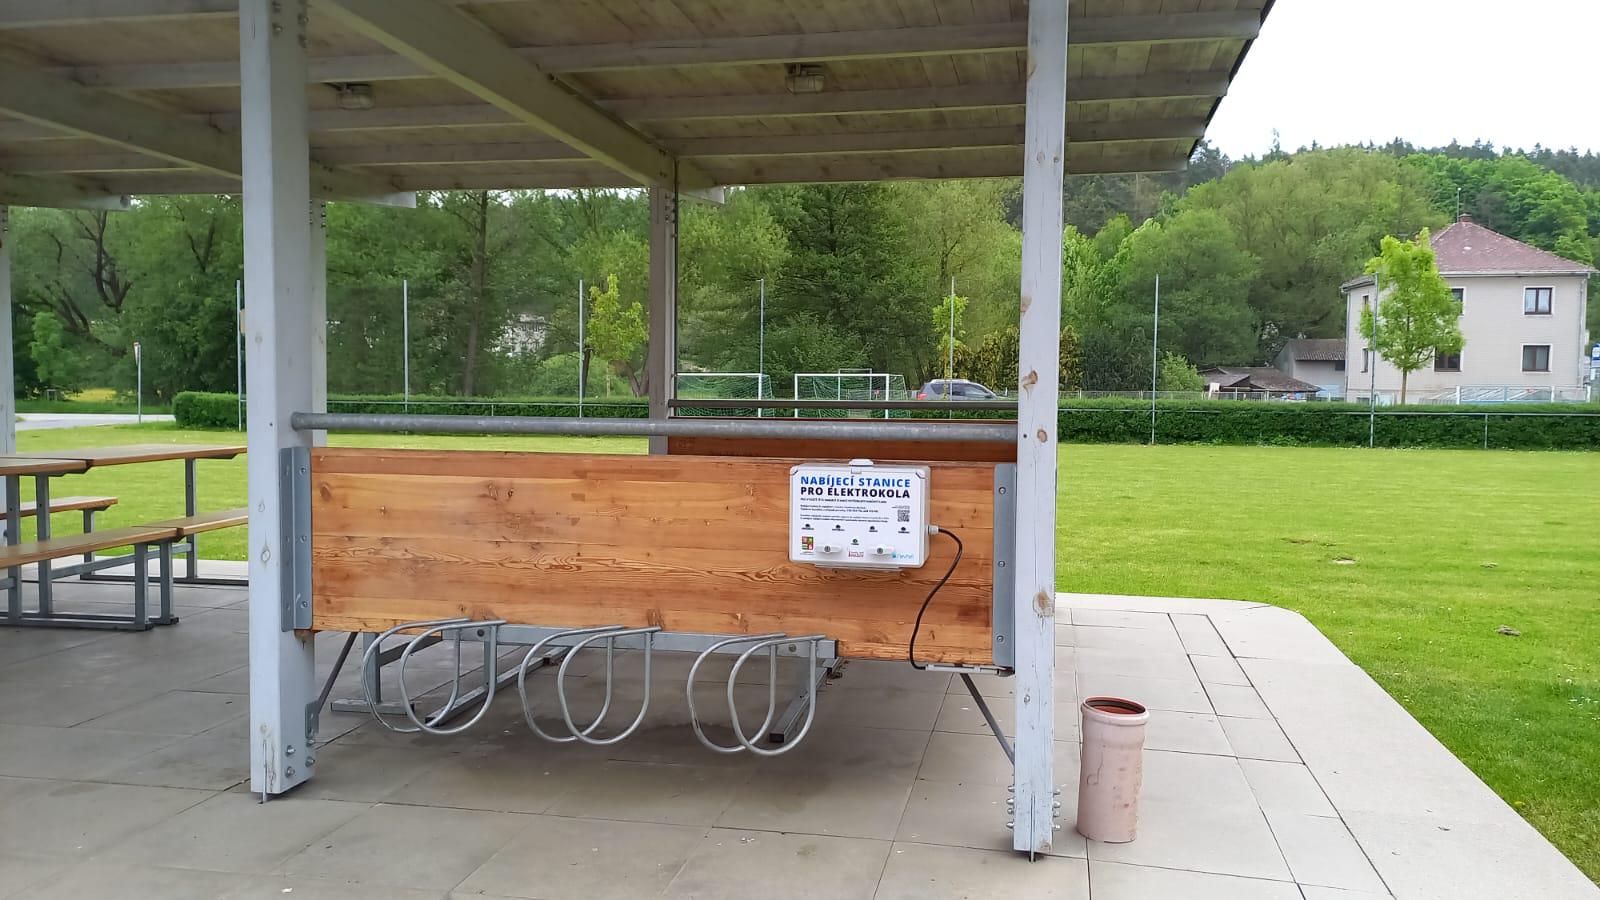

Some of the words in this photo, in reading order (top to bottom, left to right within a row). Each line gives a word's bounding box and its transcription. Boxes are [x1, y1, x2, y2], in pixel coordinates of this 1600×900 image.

[801, 475, 854, 487] NABÍJECÍ
[859, 478, 911, 487] STANICE
[801, 487, 823, 495] PRO
[828, 488, 910, 498] ELEKTROKOLA
